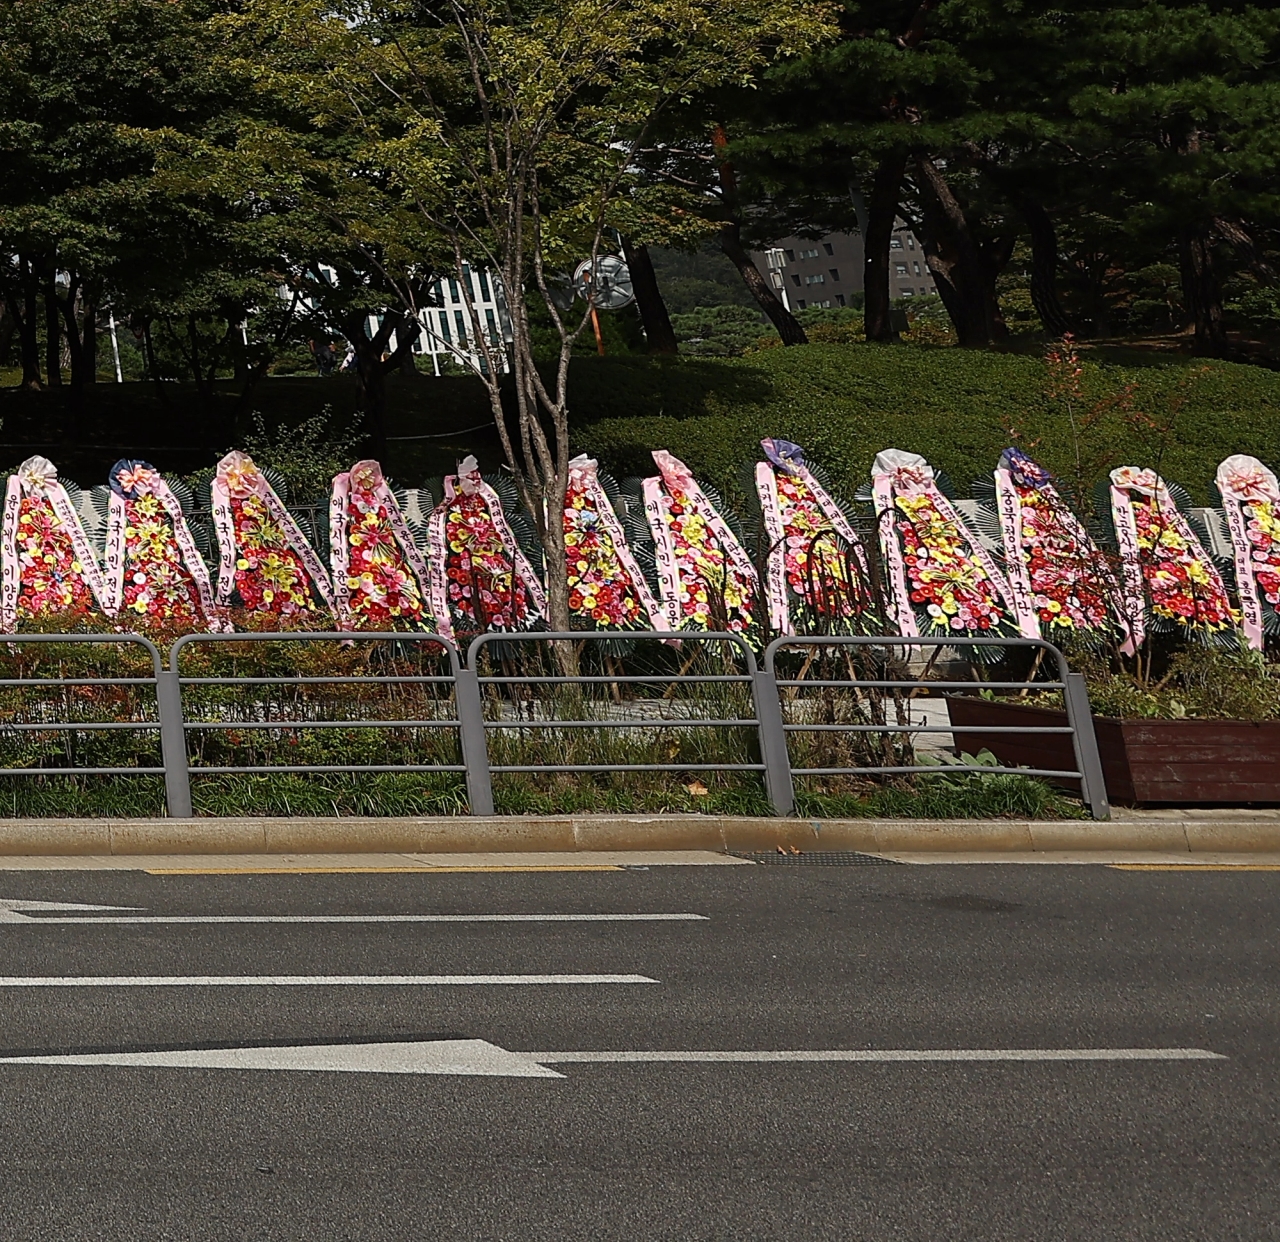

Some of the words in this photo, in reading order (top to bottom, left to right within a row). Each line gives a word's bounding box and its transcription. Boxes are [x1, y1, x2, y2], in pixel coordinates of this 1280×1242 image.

[212, 504, 234, 569] 애국시민
[330, 496, 347, 563] 애국시민
[382, 494, 403, 530] 지귀연
[647, 500, 670, 567] 애국시민
[693, 489, 718, 522] 바로
[104, 506, 122, 570] 애국시민
